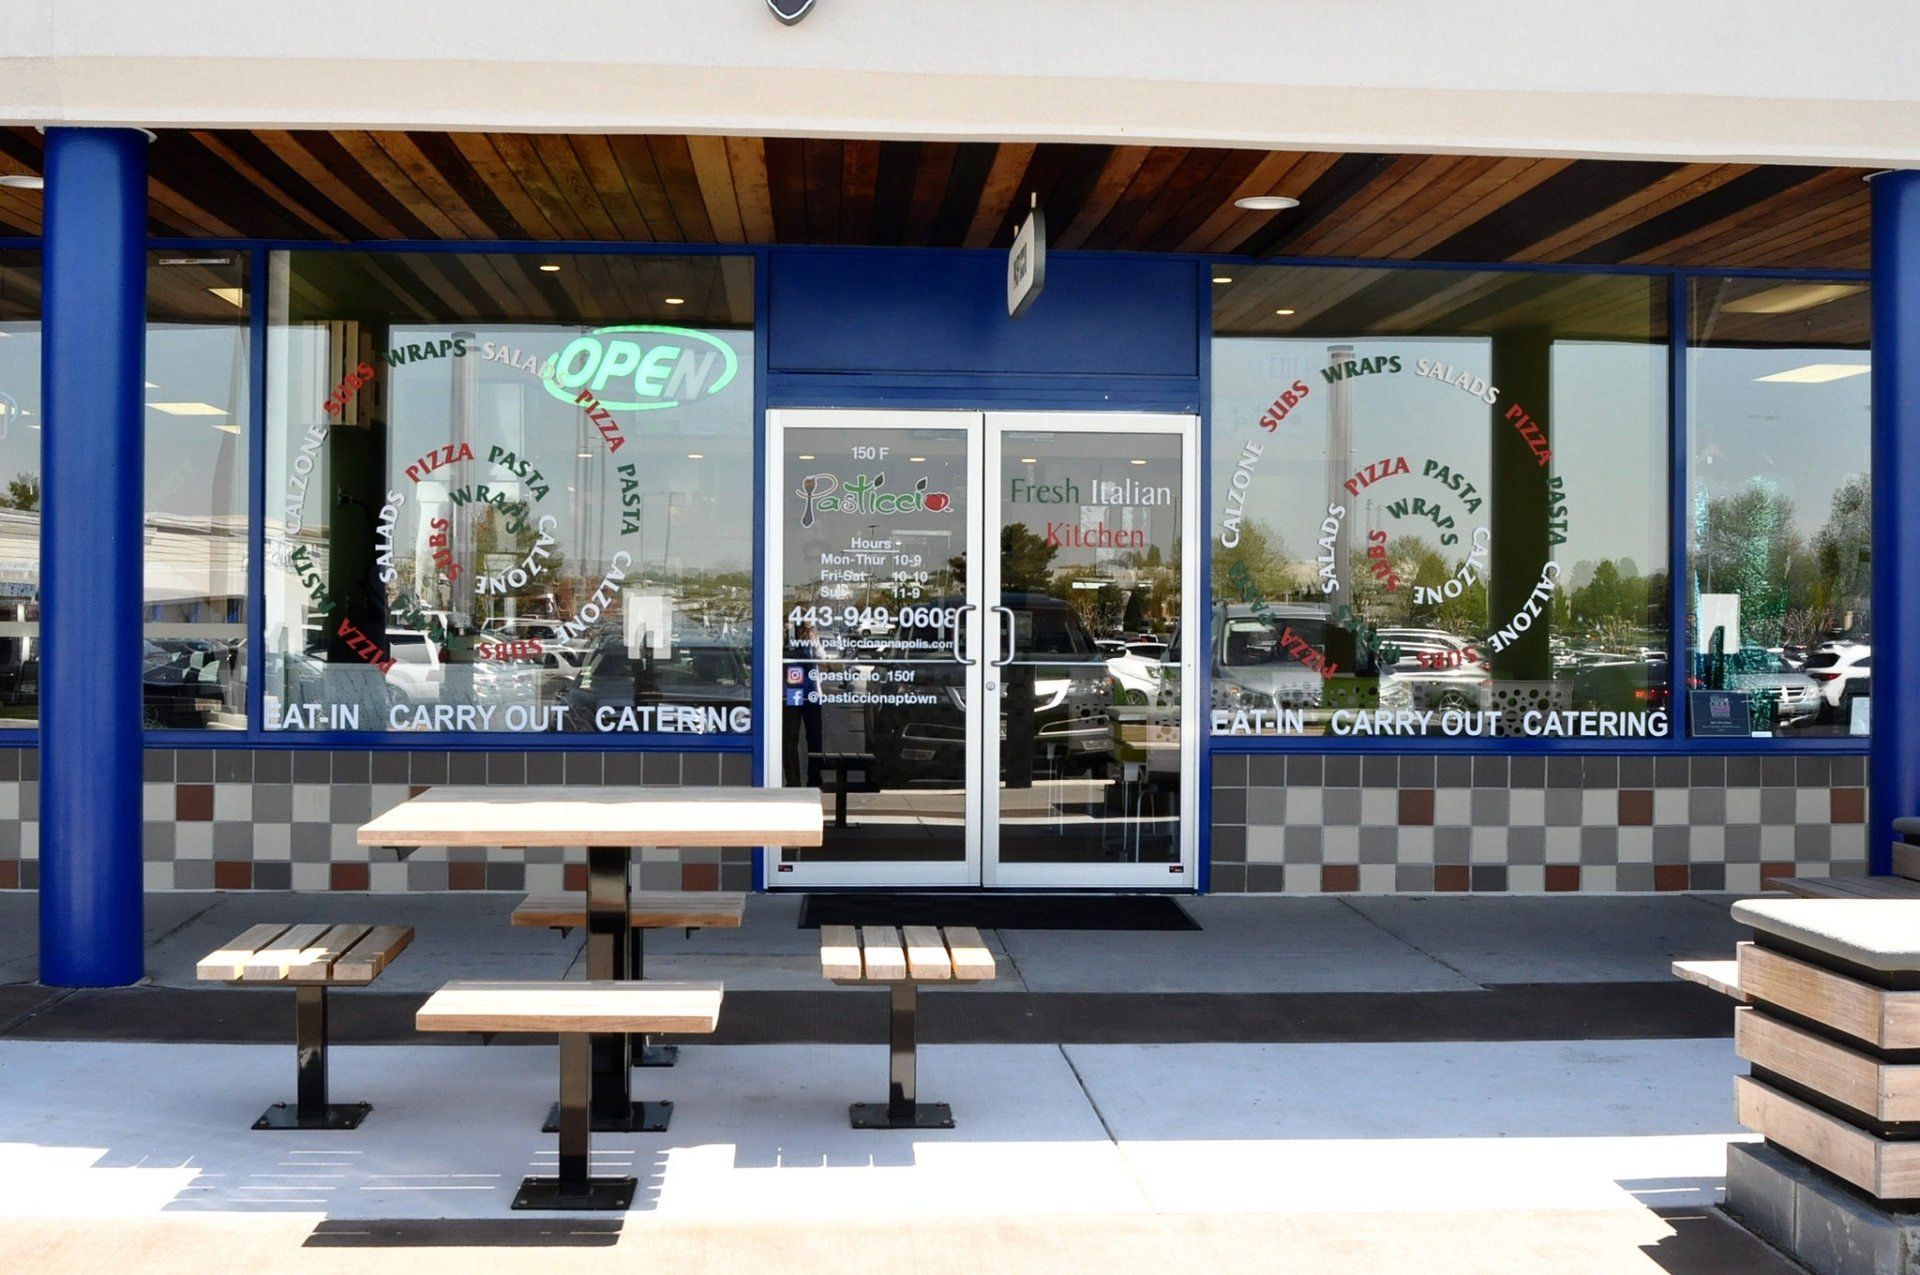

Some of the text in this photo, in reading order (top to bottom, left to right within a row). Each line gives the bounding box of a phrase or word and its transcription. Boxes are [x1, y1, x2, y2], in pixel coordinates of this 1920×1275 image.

[383, 339, 467, 367] WRAPS
[556, 337, 717, 399] OPEN
[1320, 356, 1402, 384] WRAPS
[323, 362, 375, 417] SUBS
[1259, 380, 1310, 433] SUBS
[1415, 358, 1500, 405] SALADS
[574, 388, 626, 454] PIZZA
[1504, 403, 1555, 467] PIZZA
[284, 424, 328, 535] CALZONE
[405, 443, 474, 484] PIZZA
[488, 445, 550, 502] PASTA
[851, 447, 889, 460] 150 F
[1344, 456, 1411, 496] PIZZA
[449, 485, 524, 534] WRAPS
[617, 463, 640, 536] PASTA
[796, 472, 954, 528] Pasticcio
[1010, 478, 1170, 505] Fresh Italian
[1221, 440, 1264, 548] CALZONE
[1423, 459, 1482, 514] PASTA
[1547, 476, 1567, 547] PASTA
[374, 490, 405, 583] SALADS
[851, 538, 892, 549] Hours
[1046, 522, 1144, 548] Kitchen
[1318, 502, 1346, 594] SALADS
[1386, 498, 1458, 545] WRAPS
[429, 517, 463, 582] SUBS
[475, 515, 557, 595] CALZONE
[821, 554, 922, 567] Mon-Thur 10-9
[821, 570, 928, 582] Fri-Sat 10-10
[1368, 530, 1401, 592] SUBS
[1413, 527, 1491, 605] CALZONE
[291, 545, 336, 614] PASTA
[554, 550, 631, 644] CALZONE
[892, 588, 921, 599] 11-9
[788, 606, 955, 628] 443-949-0608
[1487, 561, 1560, 653] CALZONE
[337, 617, 397, 675] PIZZA
[479, 636, 543, 662] SUBS
[1279, 626, 1338, 680] PIZZA
[1416, 646, 1478, 670] SUBS
[263, 704, 751, 732] EAT-IN CARRY OUT CATERING
[808, 691, 937, 705] @pasticcionaptown
[1211, 709, 1668, 737] EAT-IN CARRY OUT CATERING
